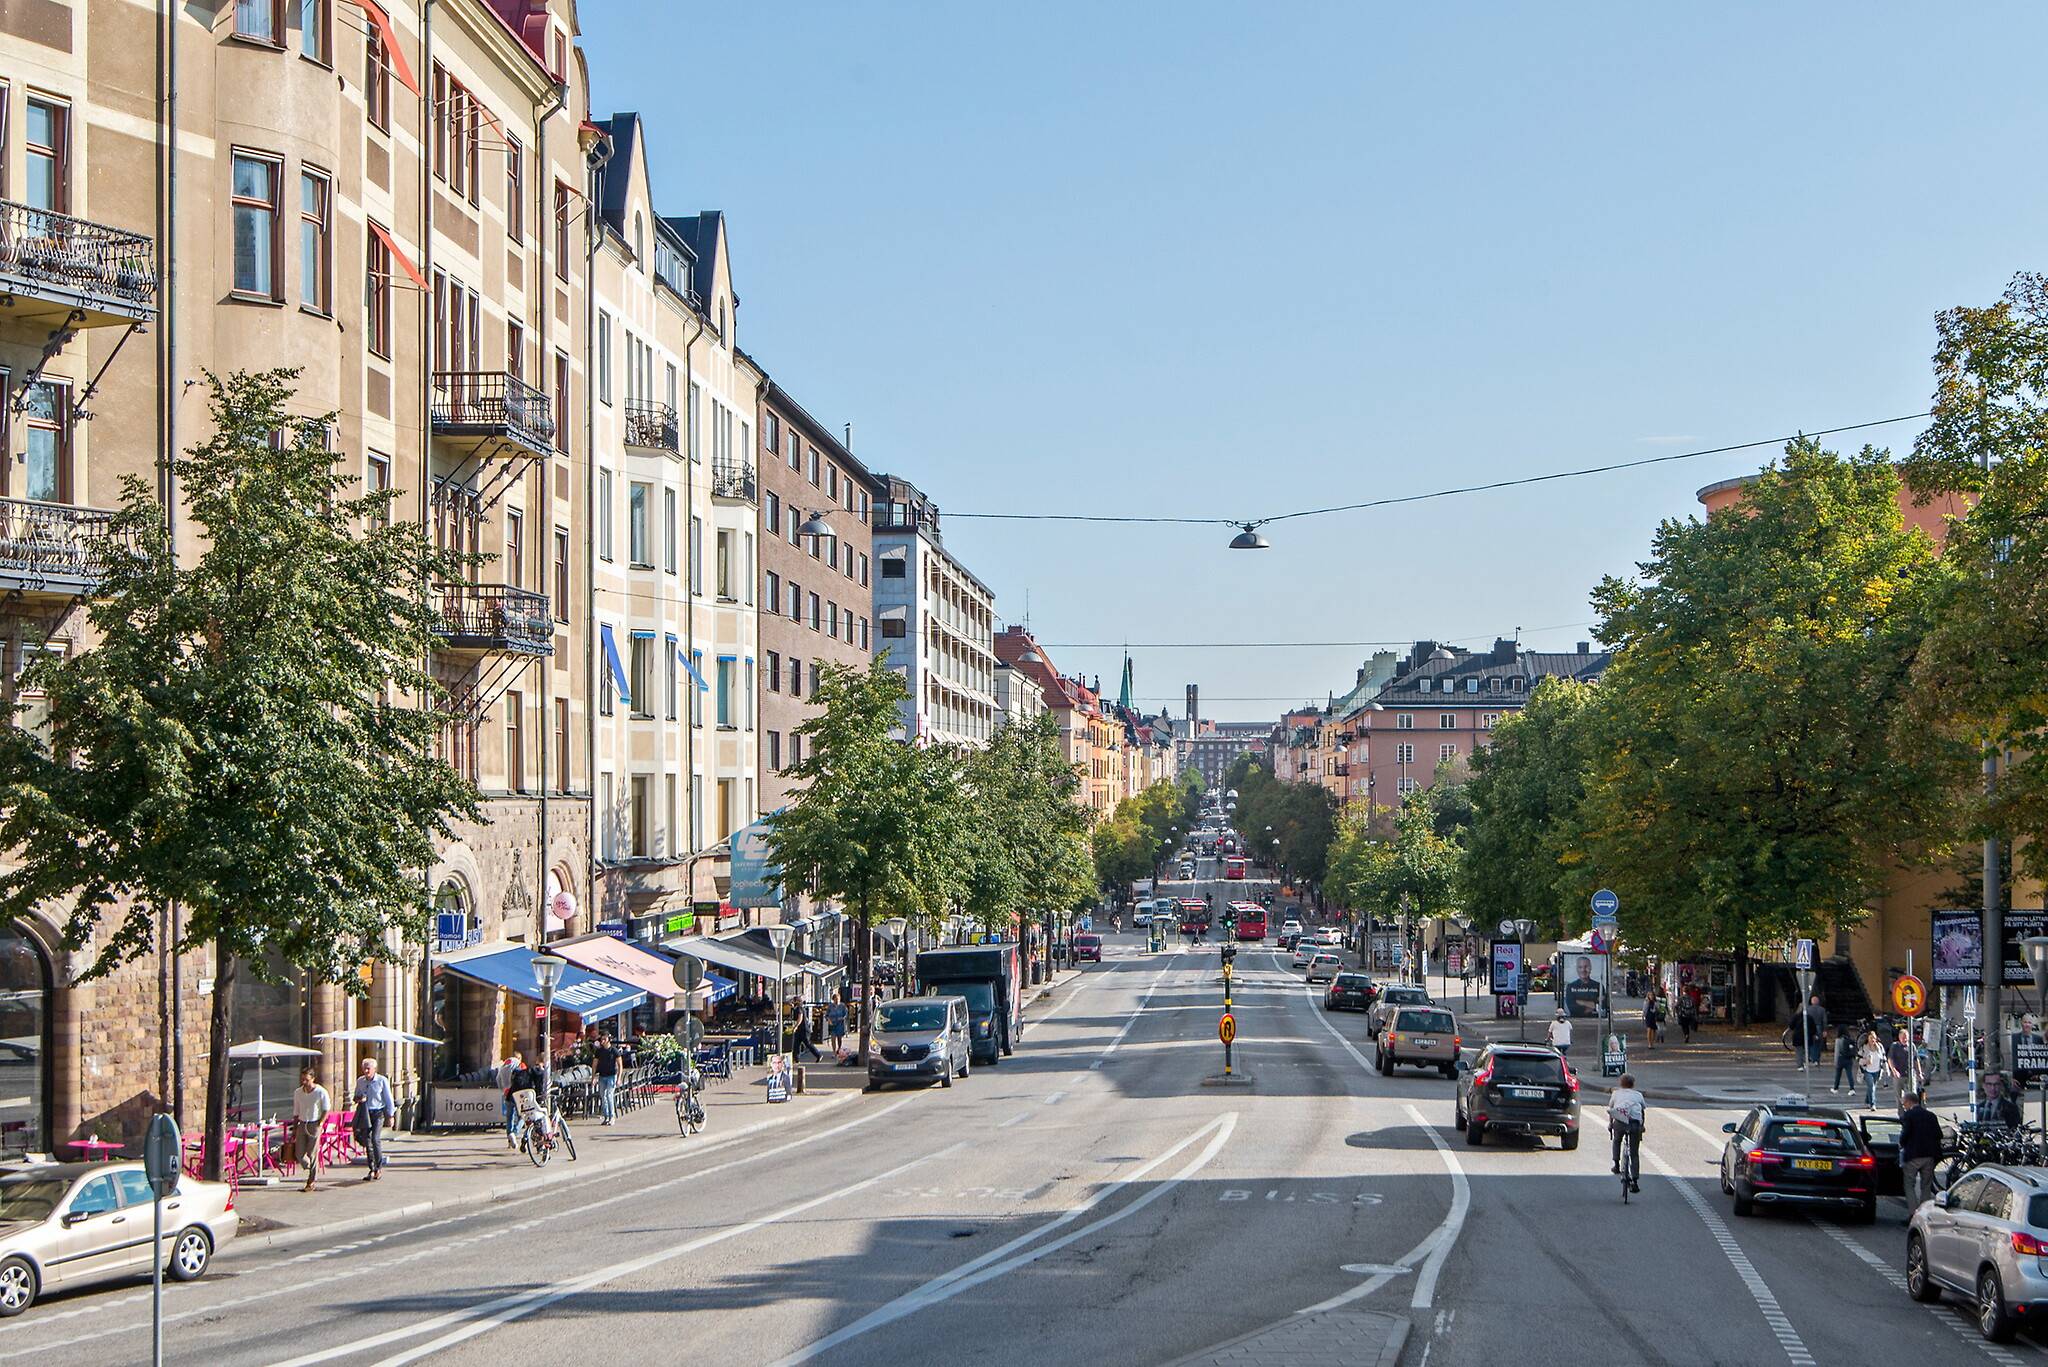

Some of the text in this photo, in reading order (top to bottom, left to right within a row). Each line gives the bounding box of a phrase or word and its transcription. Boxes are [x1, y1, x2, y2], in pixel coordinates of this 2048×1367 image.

[1496, 946, 1514, 954] Rea
[445, 1099, 494, 1112] itamae
[1219, 1189, 1384, 1205] BUSS
